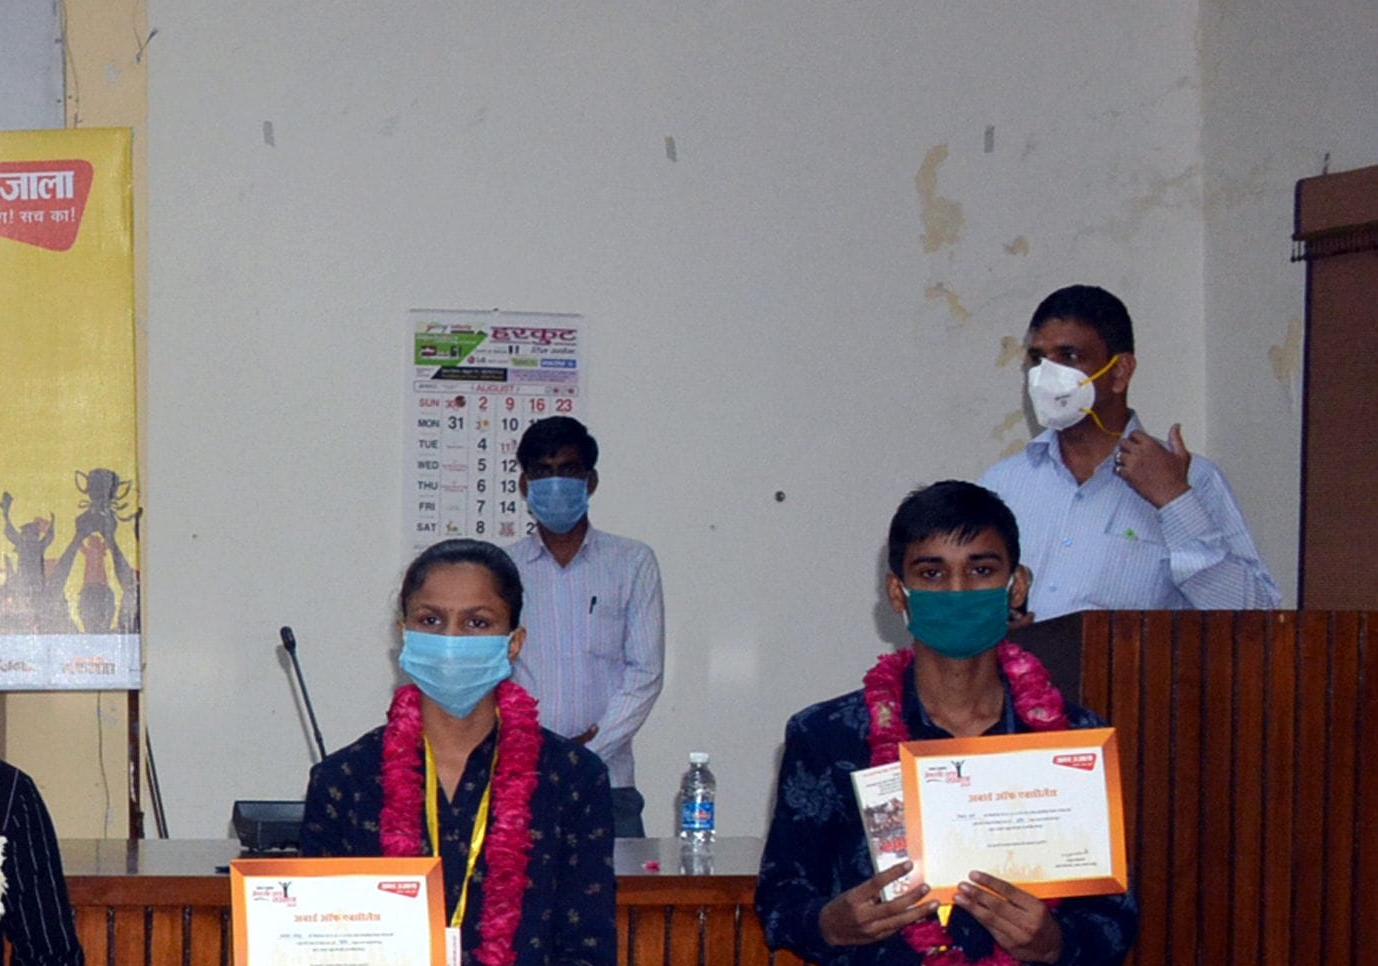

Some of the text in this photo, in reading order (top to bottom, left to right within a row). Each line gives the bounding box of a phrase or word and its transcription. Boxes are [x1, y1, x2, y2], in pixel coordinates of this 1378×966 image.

[19, 210, 44, 223] सच
[51, 207, 76, 222] का!
[418, 397, 440, 408] SUN
[478, 397, 488, 412] 2
[505, 397, 515, 412] 9
[530, 398, 545, 412] 16
[556, 398, 573, 412] 23
[418, 418, 440, 428] MON
[448, 416, 464, 430] 31
[501, 418, 518, 431] 10
[418, 439, 438, 449] TUE
[477, 438, 487, 451] 4
[418, 458, 517, 473] WED 5 12
[418, 479, 517, 494] THU 6 13
[419, 500, 516, 514] FRI 7 14
[417, 522, 437, 532] SAT
[476, 521, 485, 534] 8
